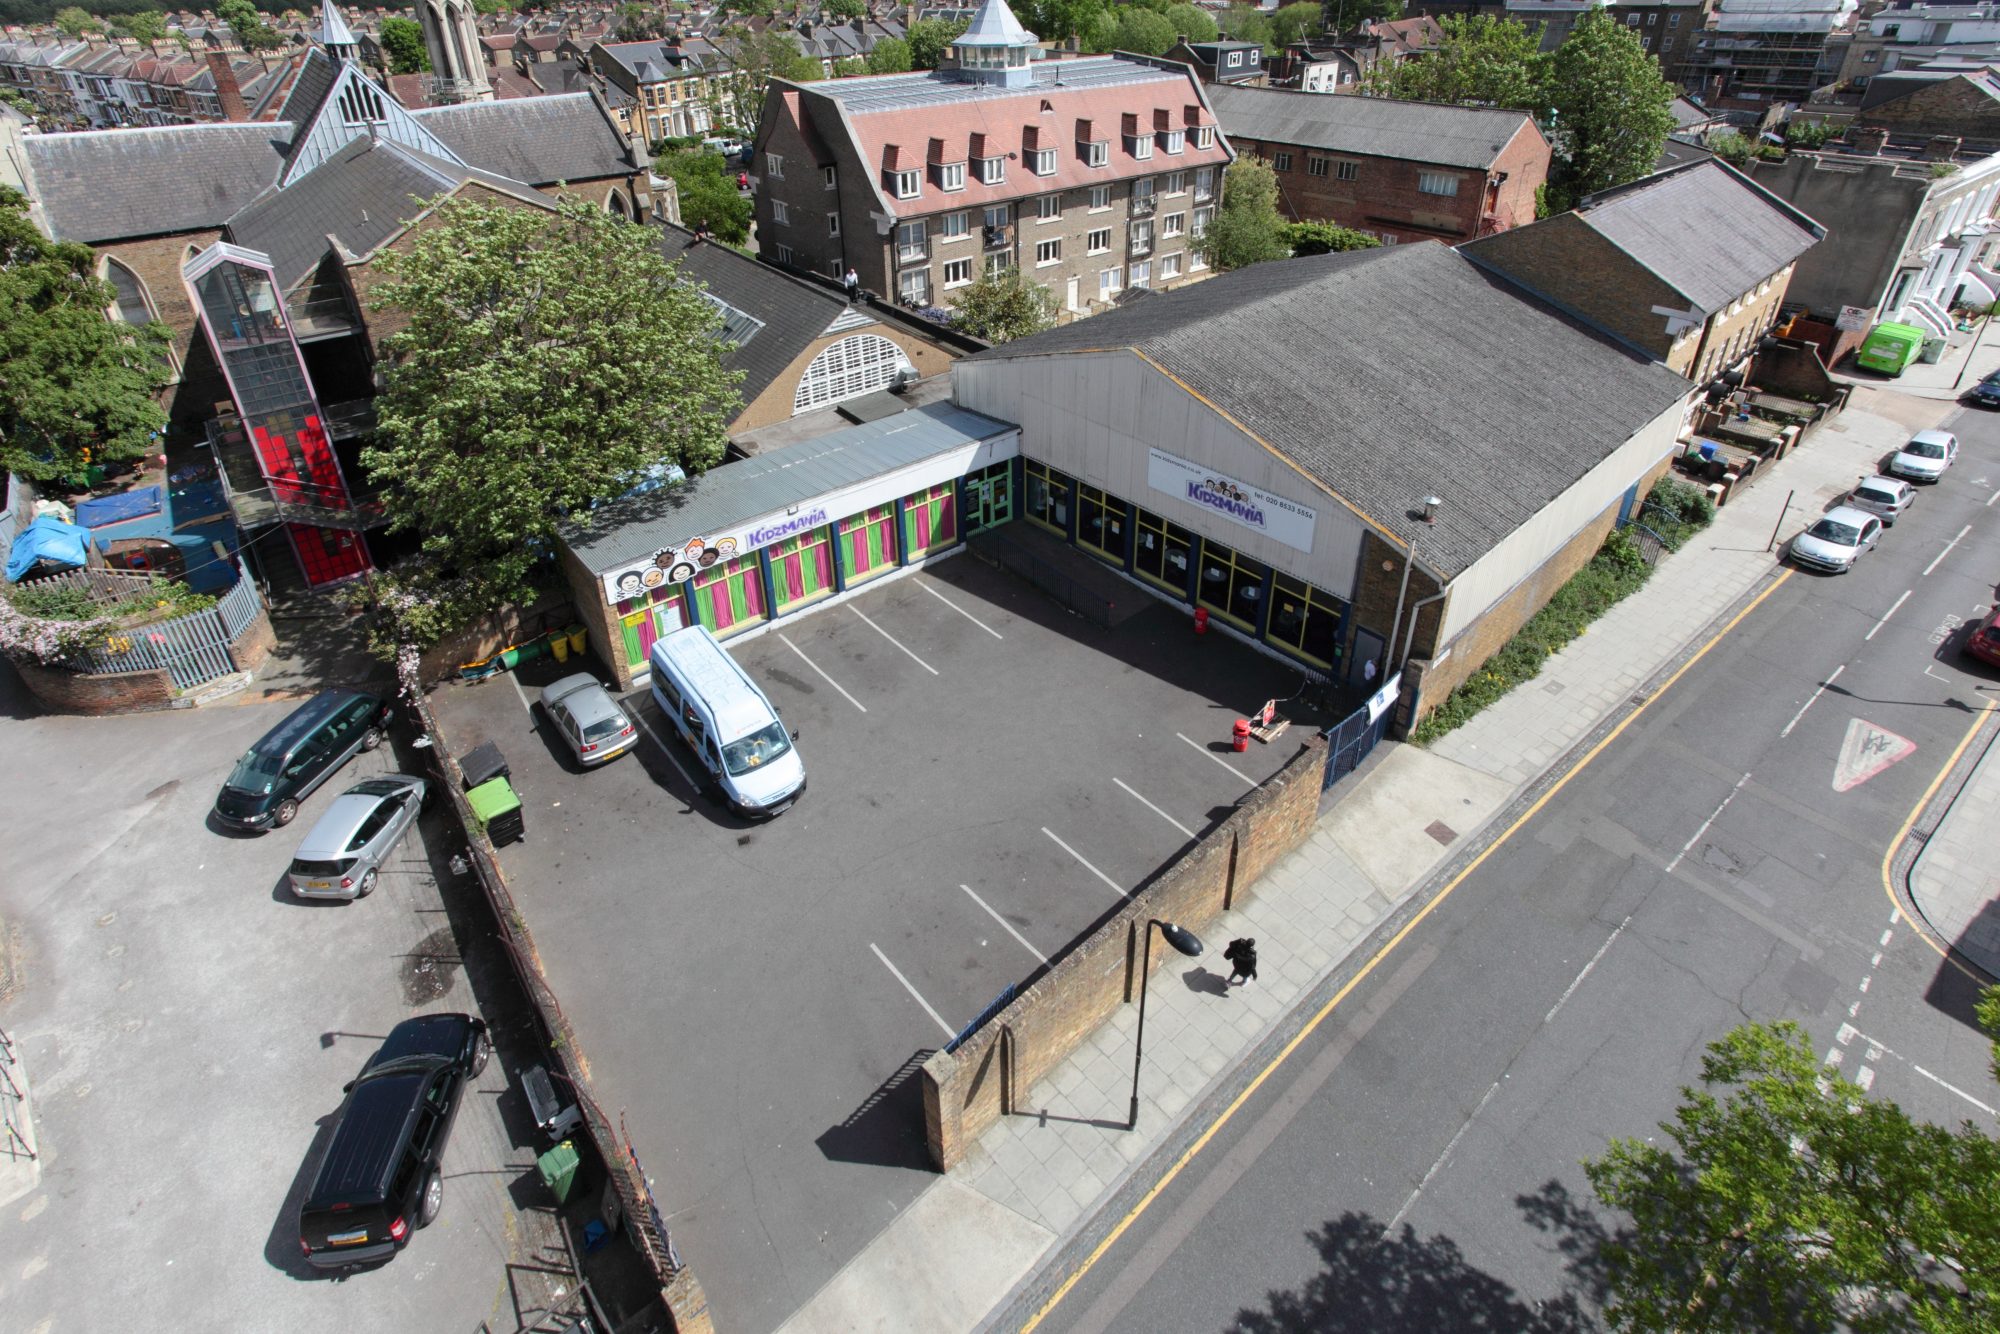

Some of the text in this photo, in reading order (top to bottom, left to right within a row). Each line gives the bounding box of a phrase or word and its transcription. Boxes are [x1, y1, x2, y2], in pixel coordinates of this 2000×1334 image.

[1265, 496, 1279, 506] 020
[1279, 501, 1296, 513] 8533
[1296, 508, 1313, 520] 5556
